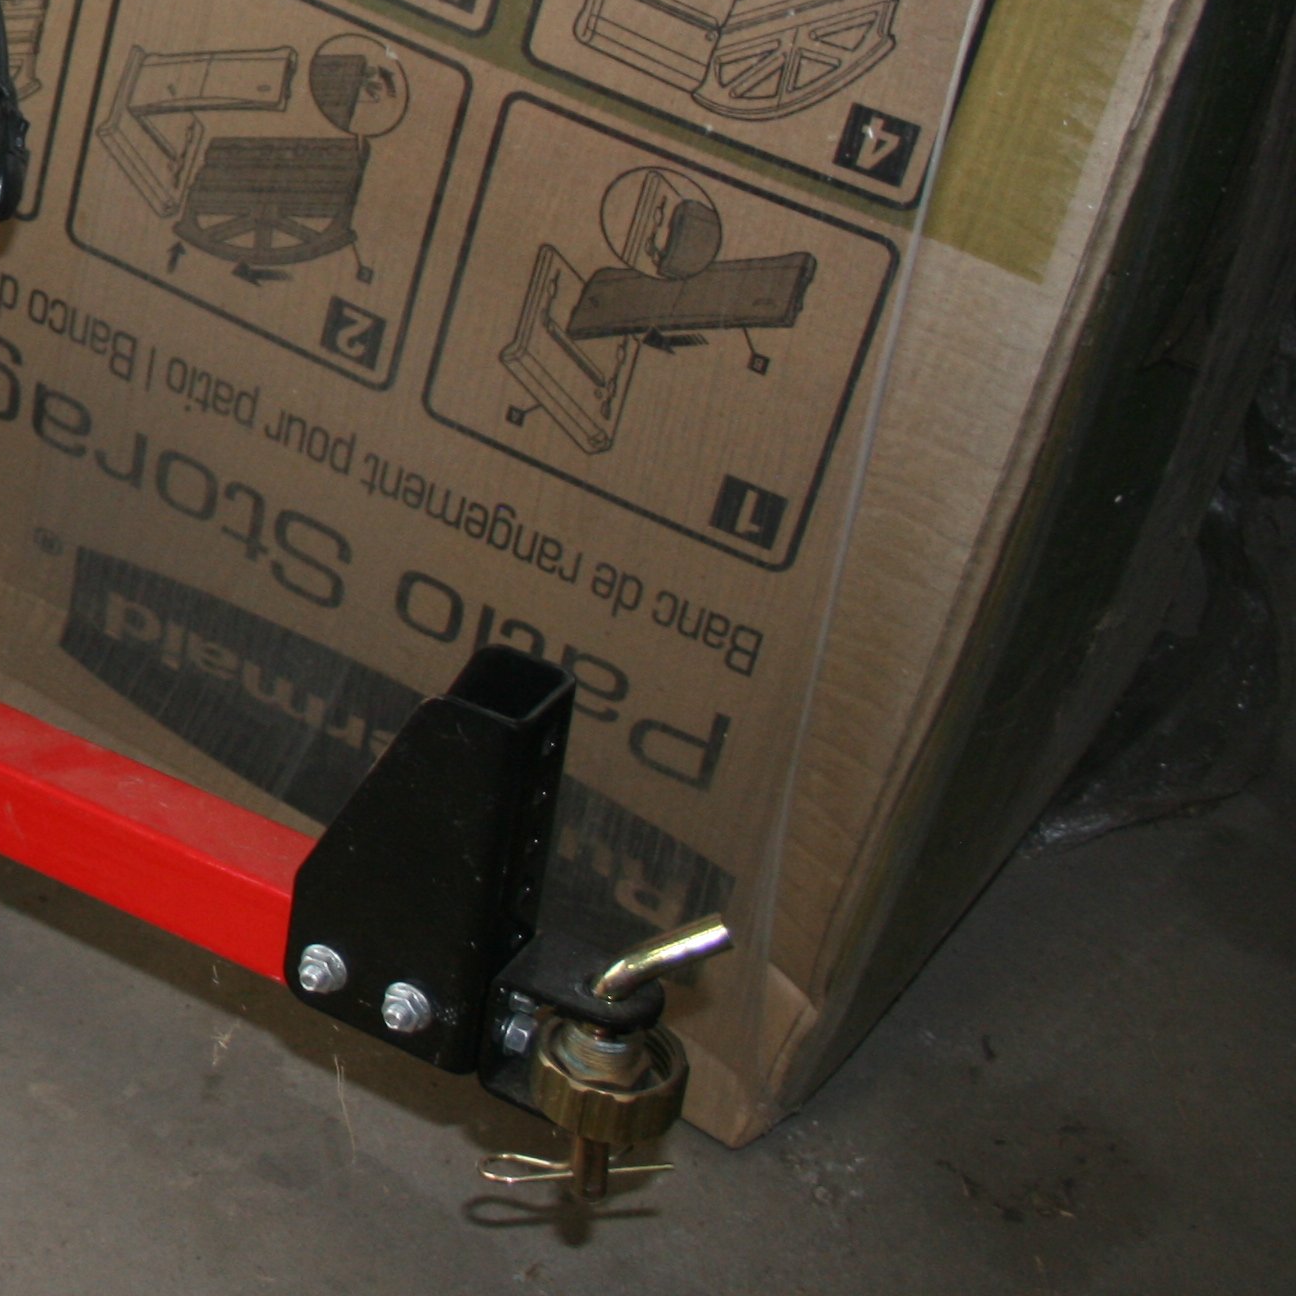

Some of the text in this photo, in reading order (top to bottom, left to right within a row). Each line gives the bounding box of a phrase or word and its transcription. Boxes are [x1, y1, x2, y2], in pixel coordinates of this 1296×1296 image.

[858, 116, 898, 172] 4
[28, 289, 138, 383] Banco
[335, 304, 373, 357] 2
[165, 356, 261, 429] patio
[264, 408, 357, 477] pour
[359, 453, 584, 587] rangement
[734, 489, 762, 538] 1
[592, 562, 644, 618] de
[651, 589, 765, 678] Banc
[103, 590, 692, 931] Rurmaid
